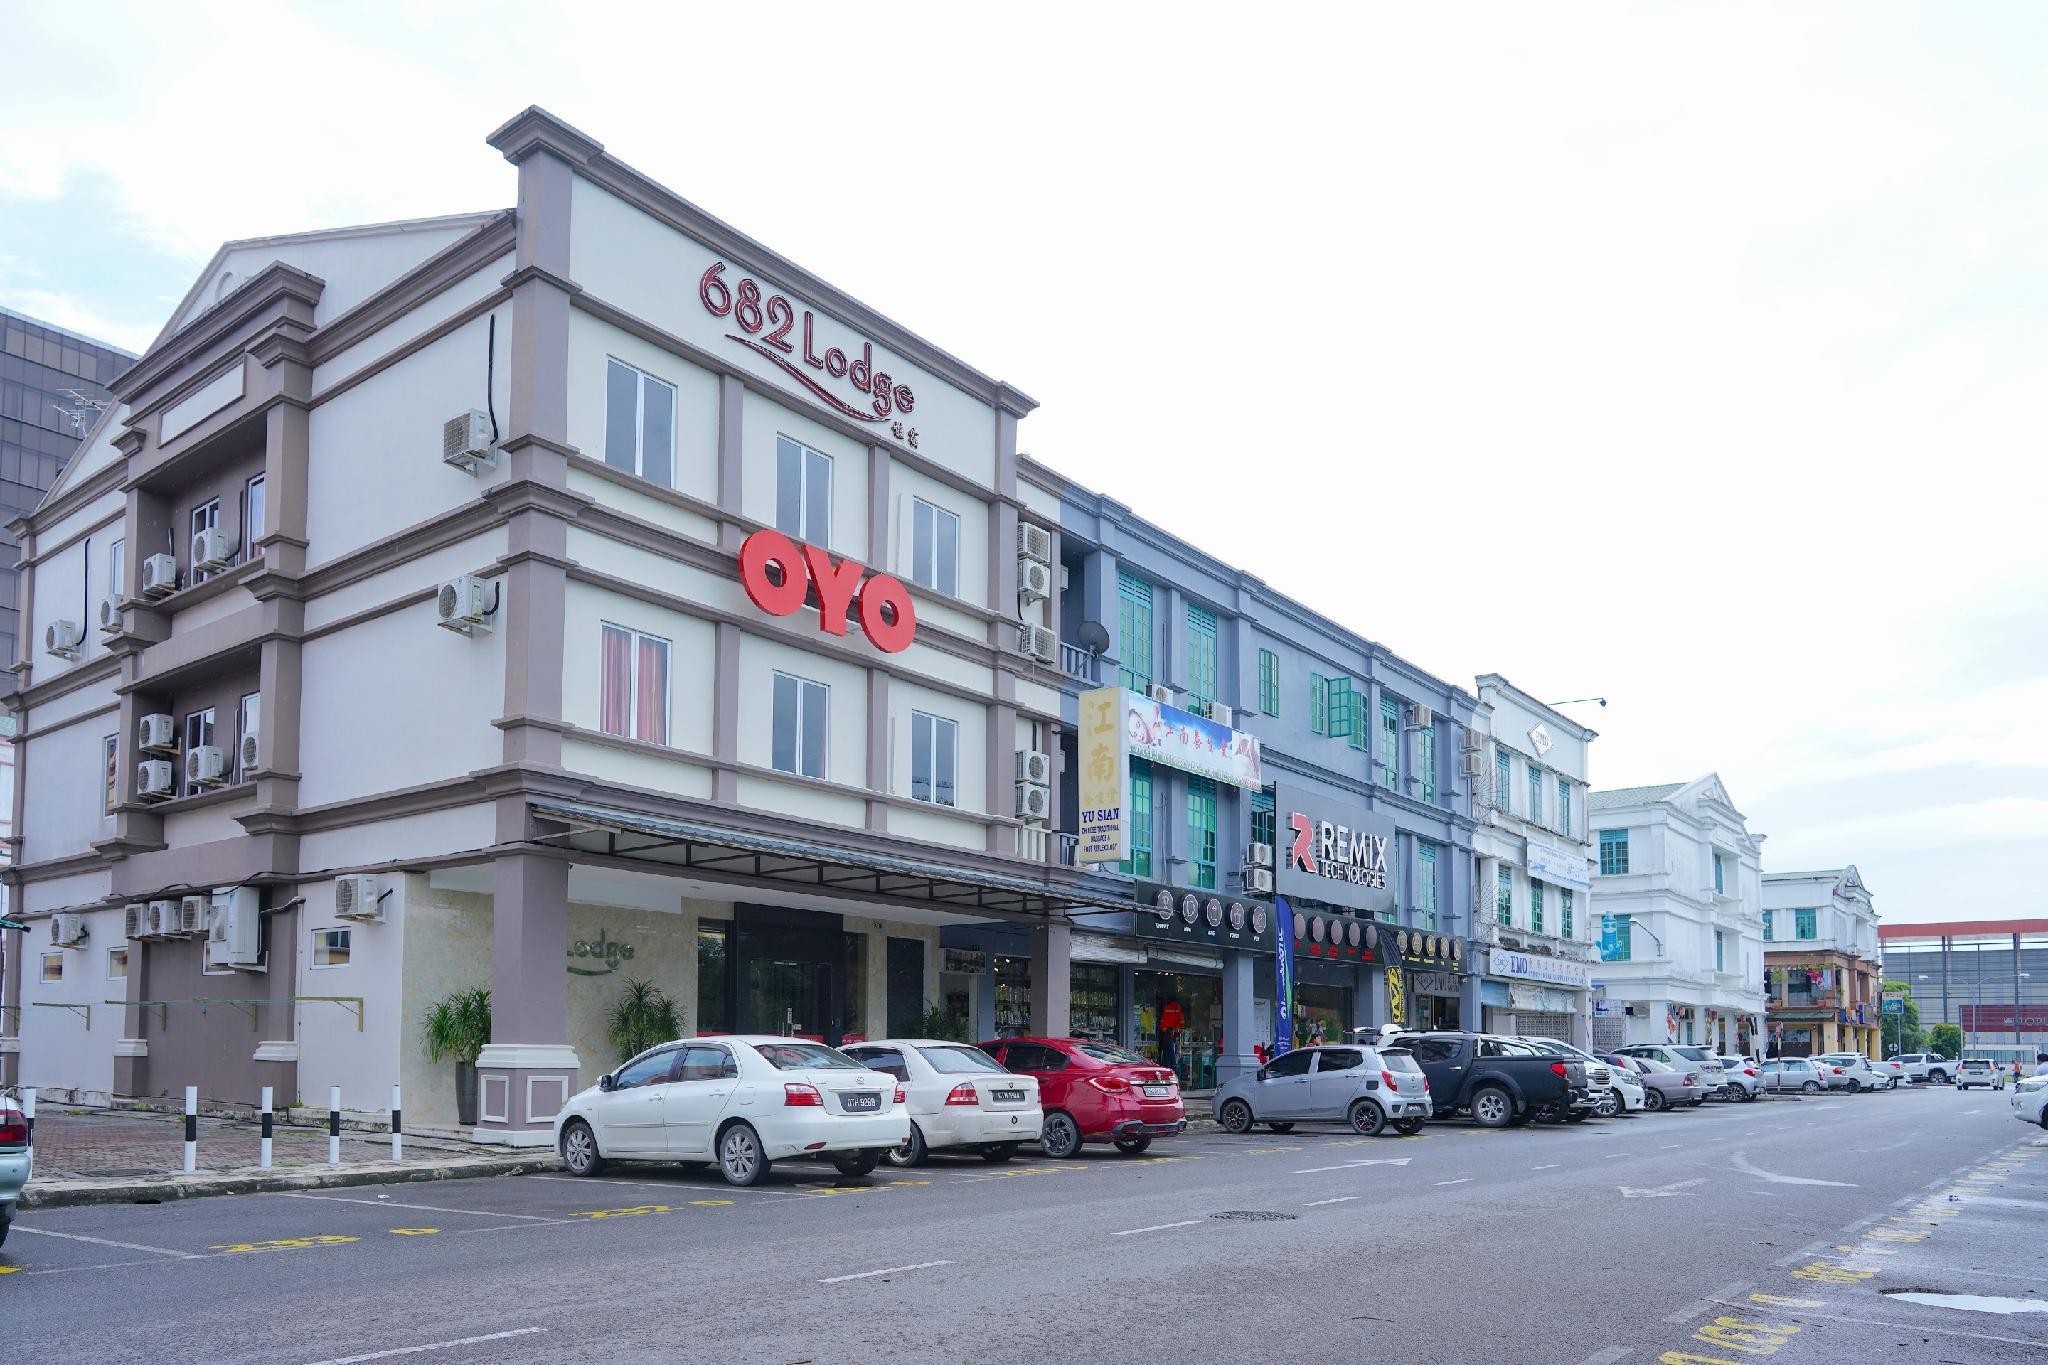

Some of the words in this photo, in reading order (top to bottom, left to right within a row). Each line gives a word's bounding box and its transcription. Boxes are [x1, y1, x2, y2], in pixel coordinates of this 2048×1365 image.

[738, 529, 917, 654] OYO
[1081, 811, 1095, 824] YU
[1097, 807, 1120, 822] SIAN
[1319, 820, 1388, 873] REMIX
[1319, 859, 1387, 890] TECHNOLOGIES
[567, 928, 635, 968] odge
